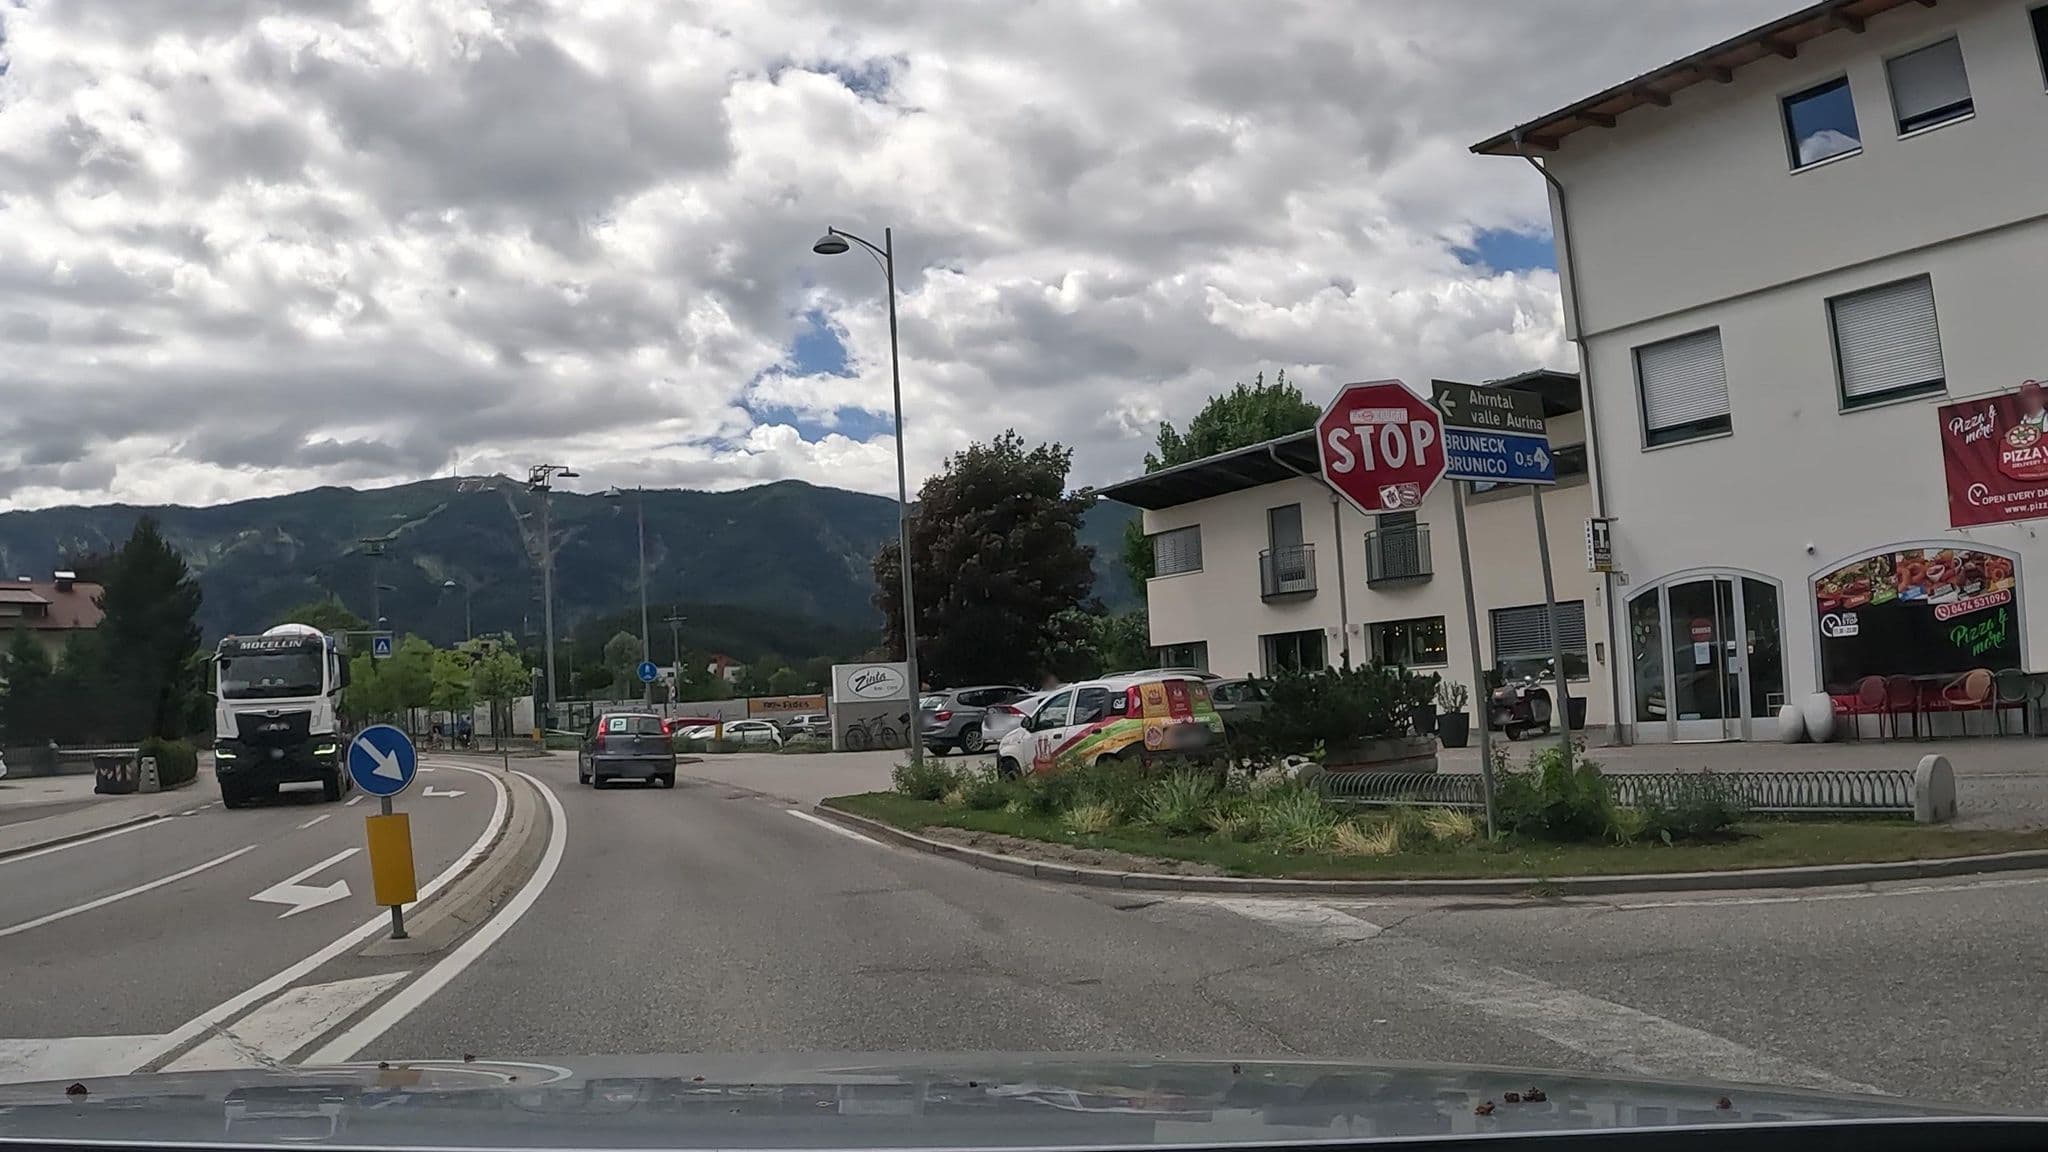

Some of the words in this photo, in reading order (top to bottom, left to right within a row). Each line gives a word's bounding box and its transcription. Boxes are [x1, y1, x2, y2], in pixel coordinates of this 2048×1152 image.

[1469, 390, 1514, 409] Ahrntal
[1471, 409, 1501, 425] valle
[1506, 412, 1544, 430] Aurina
[1949, 413, 1985, 436] Pizza
[1965, 416, 1995, 444] more!
[1328, 420, 1435, 473] STOP
[1445, 434, 1507, 454] BRUNECK
[1447, 455, 1508, 474] BRUNICO
[2003, 447, 2042, 464] PIZZA
[1982, 495, 2006, 505] OPEN
[2007, 489, 2036, 502] EVERY
[1951, 601, 1973, 613] 0474
[1975, 593, 2007, 608] 531094
[1950, 619, 1994, 648] Pizza
[240, 640, 303, 650] MOCELLIN
[614, 721, 624, 729] P
